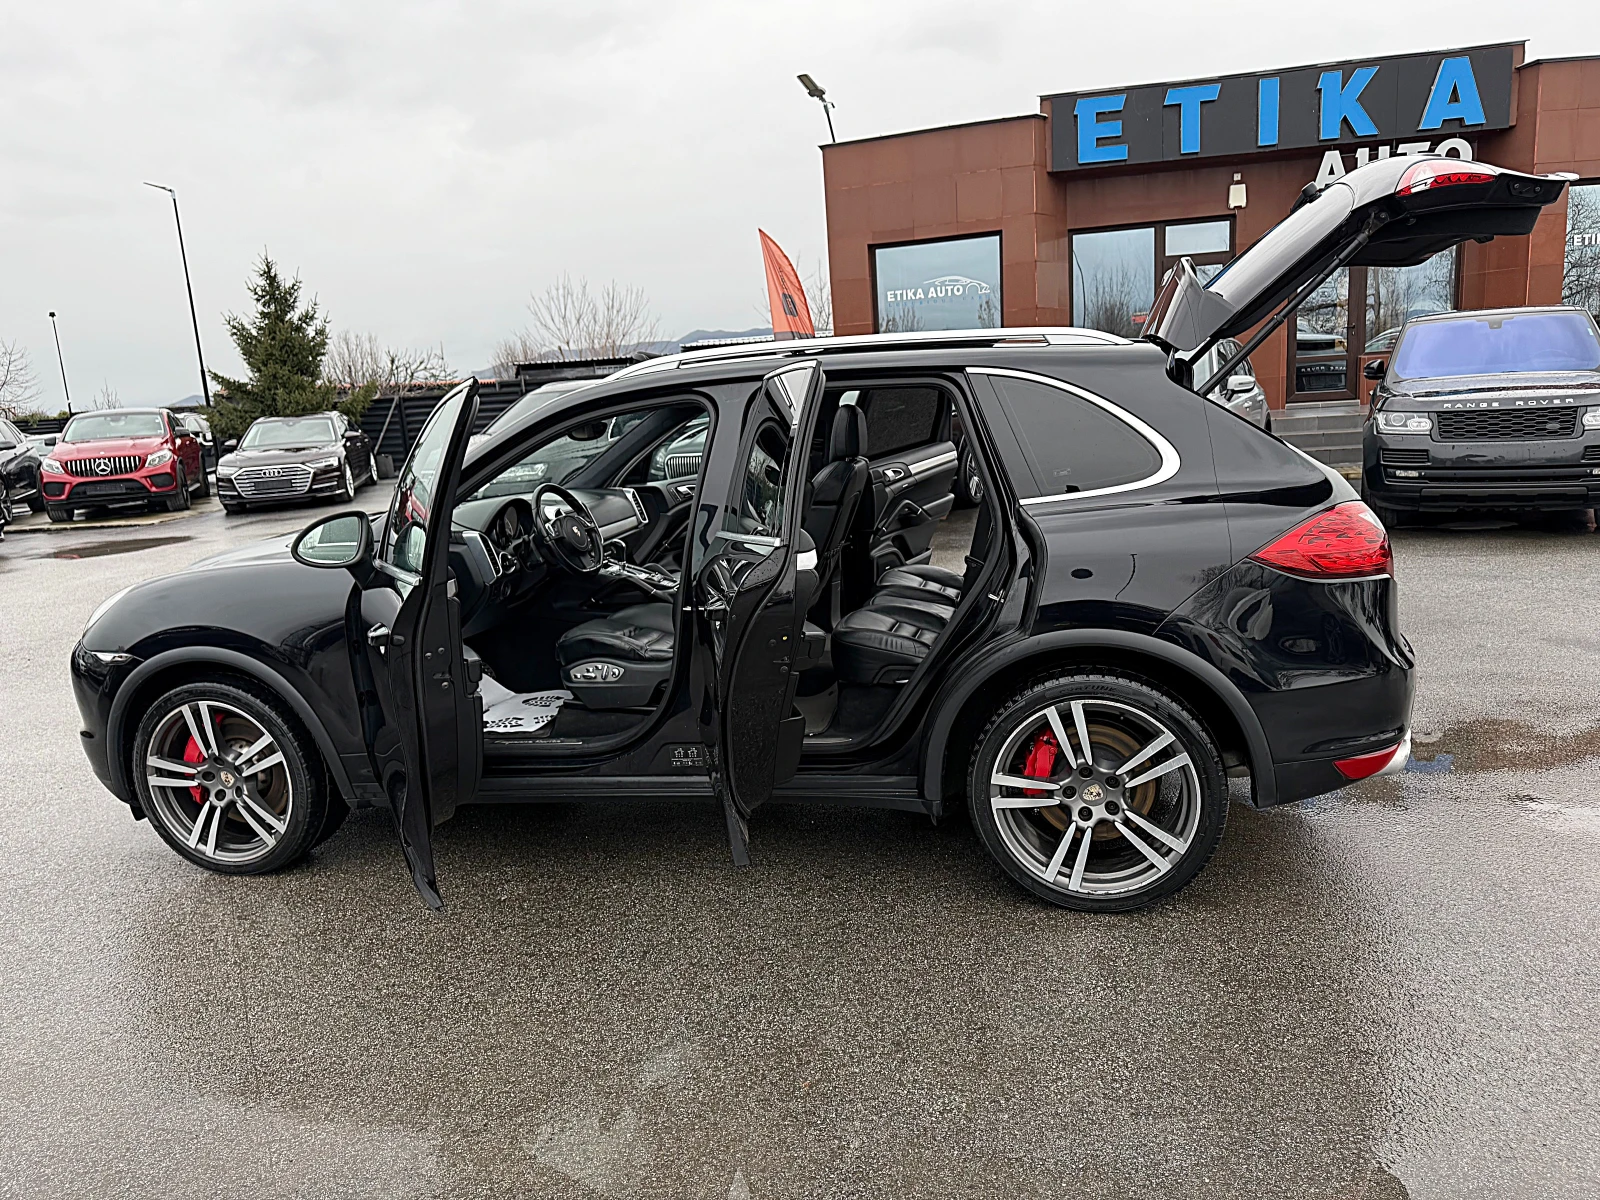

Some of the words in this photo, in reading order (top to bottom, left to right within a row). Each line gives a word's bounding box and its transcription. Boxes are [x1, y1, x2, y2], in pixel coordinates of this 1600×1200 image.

[1073, 56, 1487, 165] ETIKA
[887, 288, 925, 302] ETIKA
[928, 285, 963, 299] AUTO
[1515, 398, 1574, 406] ROVER
